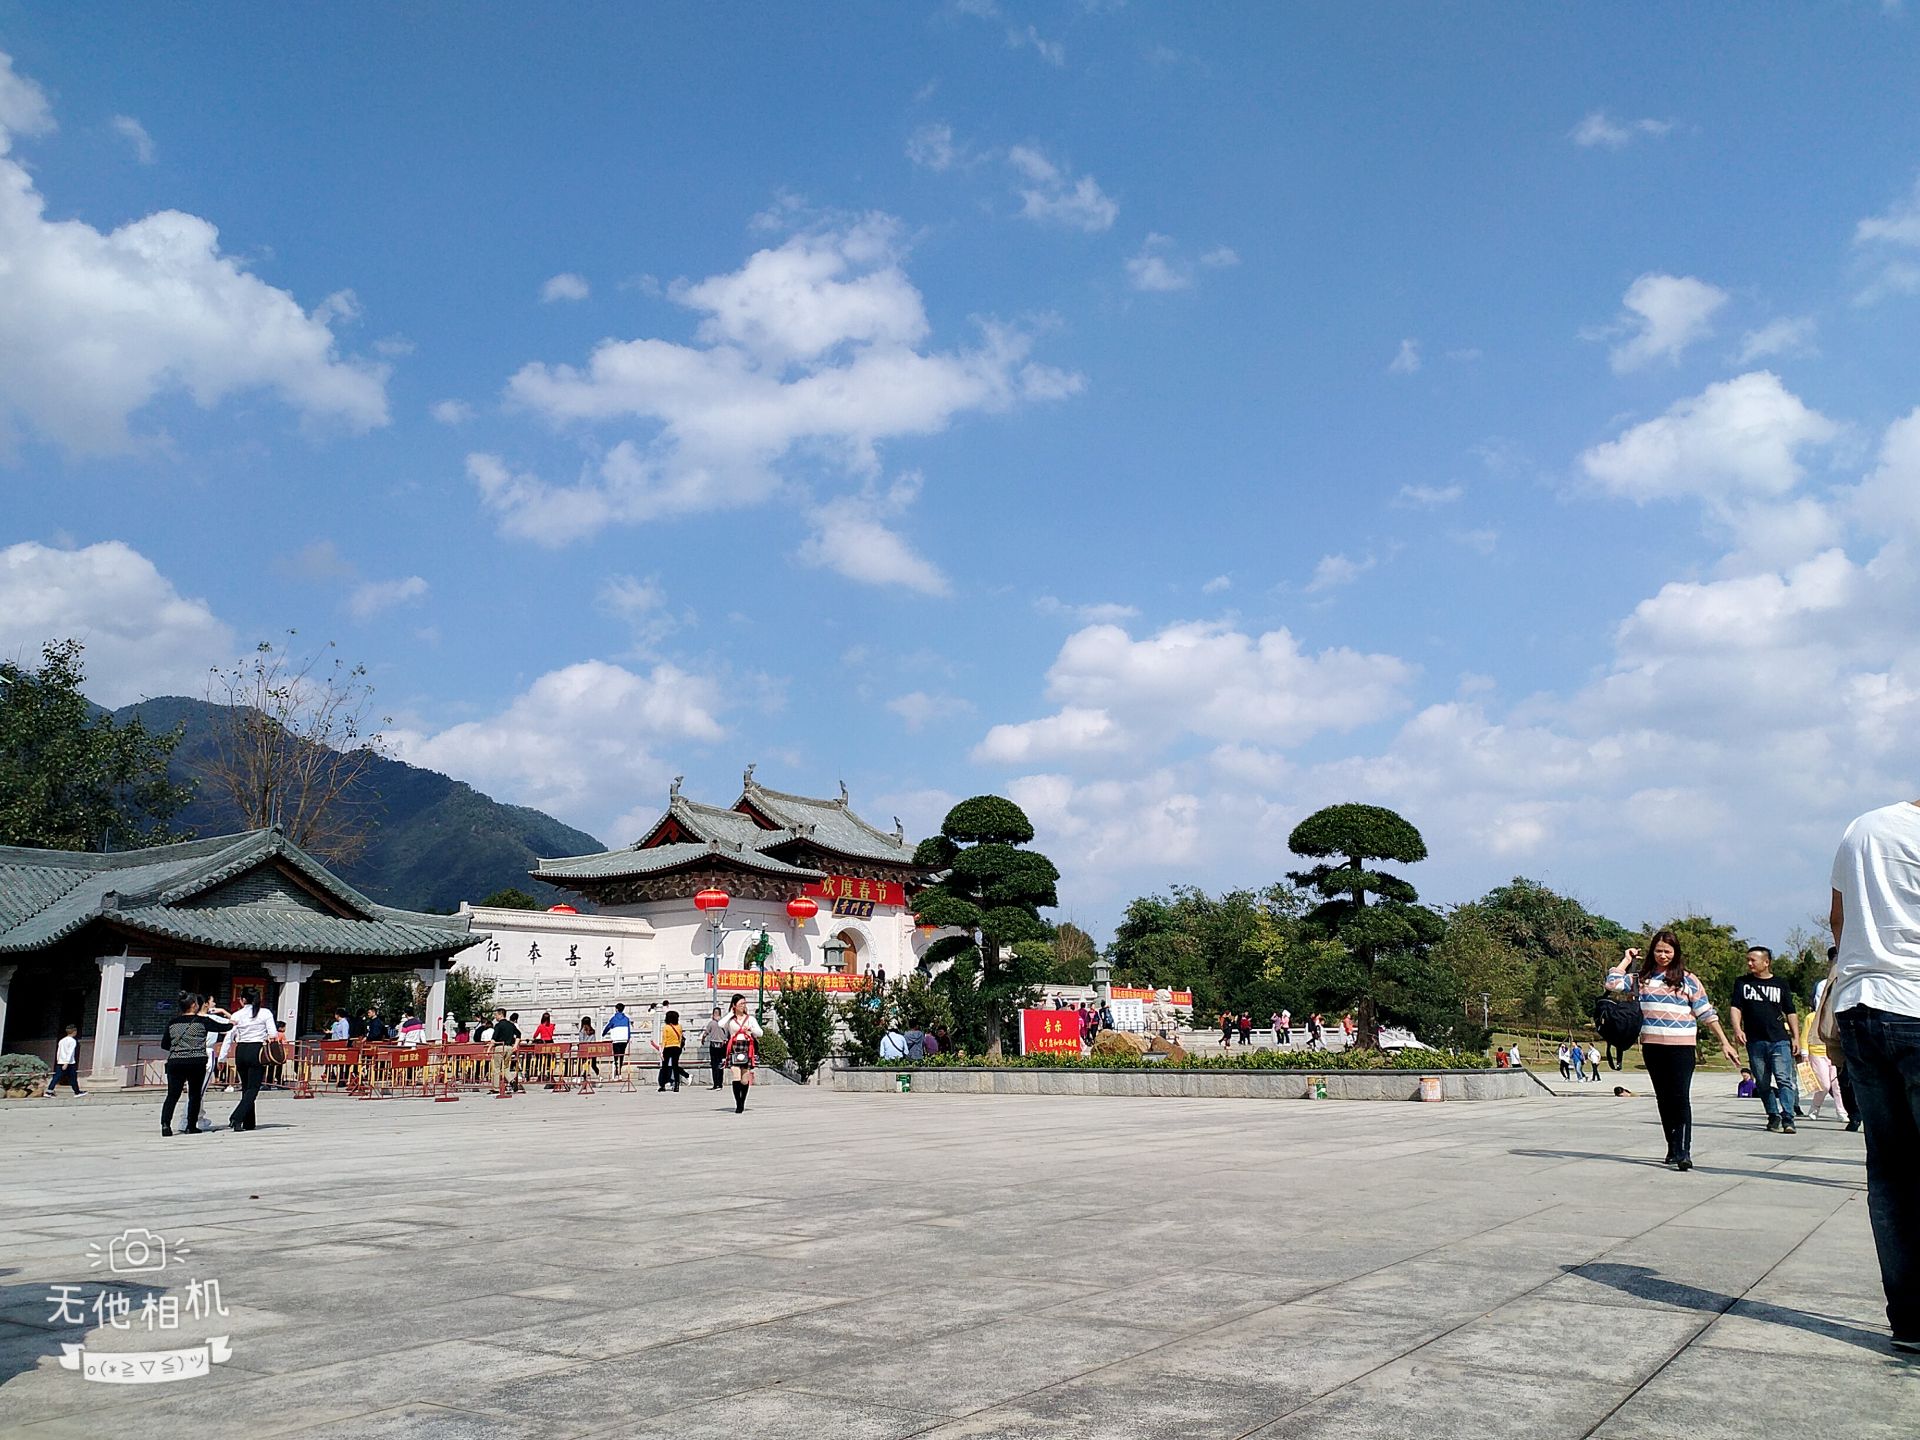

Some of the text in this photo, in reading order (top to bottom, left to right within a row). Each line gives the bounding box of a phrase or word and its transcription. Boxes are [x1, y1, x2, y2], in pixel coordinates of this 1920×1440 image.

[822, 876, 887, 902] 欢度春节
[1743, 984, 1781, 1003] CALVIN
[1044, 1017, 1062, 1034] 告示
